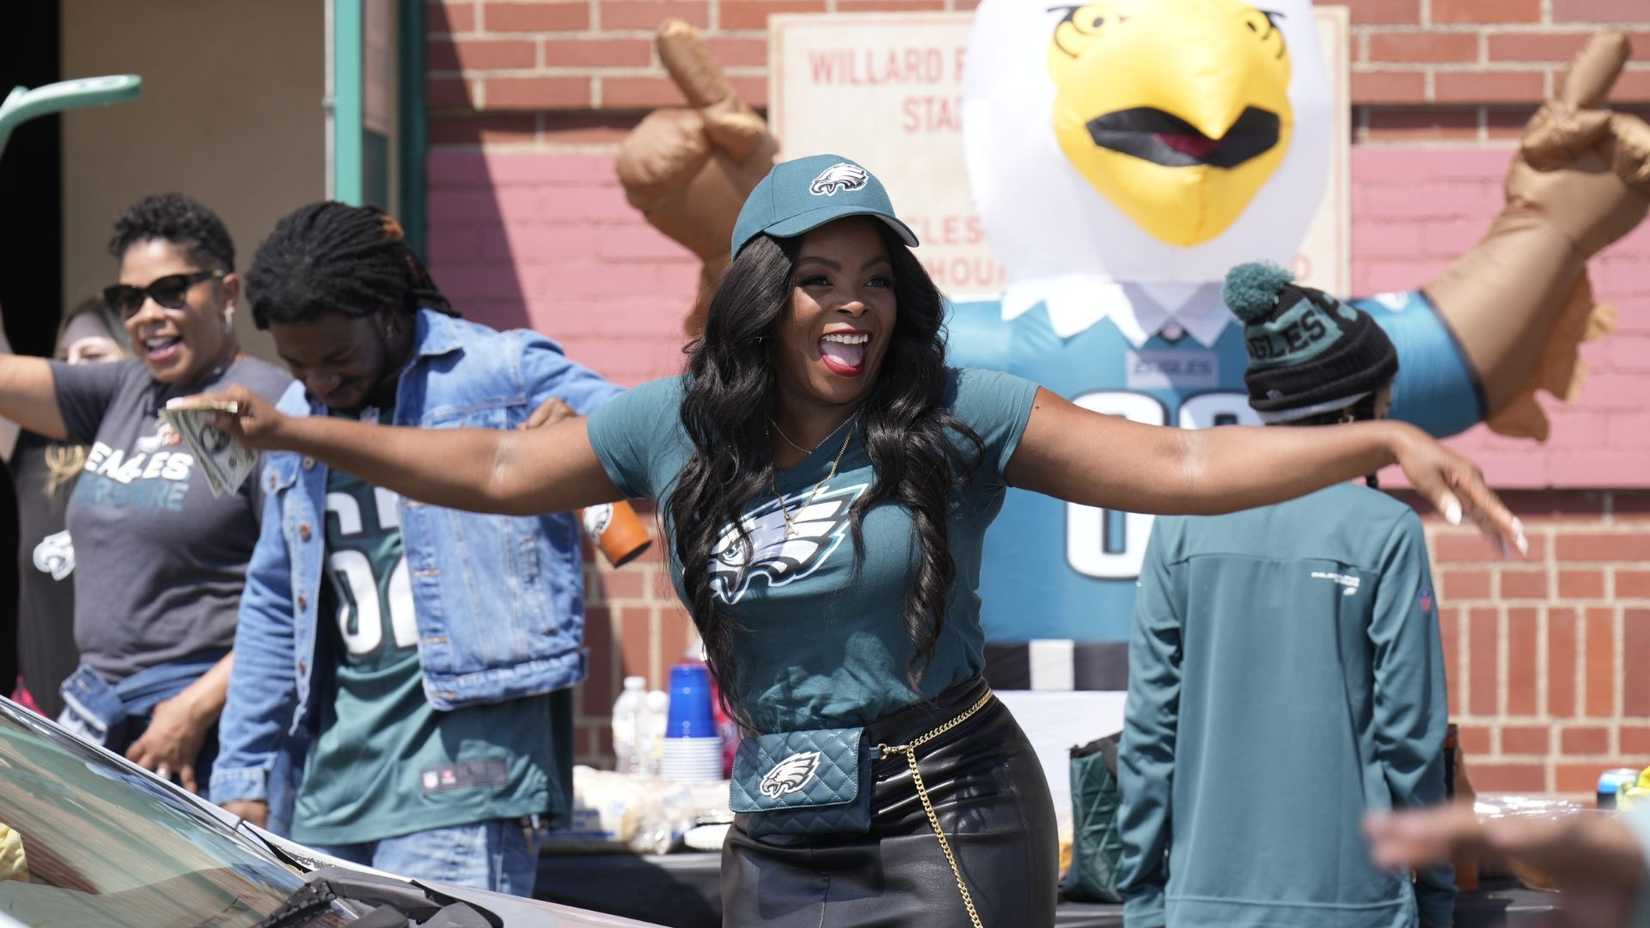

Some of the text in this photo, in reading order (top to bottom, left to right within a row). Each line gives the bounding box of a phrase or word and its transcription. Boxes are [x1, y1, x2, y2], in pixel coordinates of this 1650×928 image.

[808, 47, 943, 84] WILLARD
[903, 95, 963, 132] STA
[906, 215, 985, 245] LES
[1248, 308, 1327, 360] GLES
